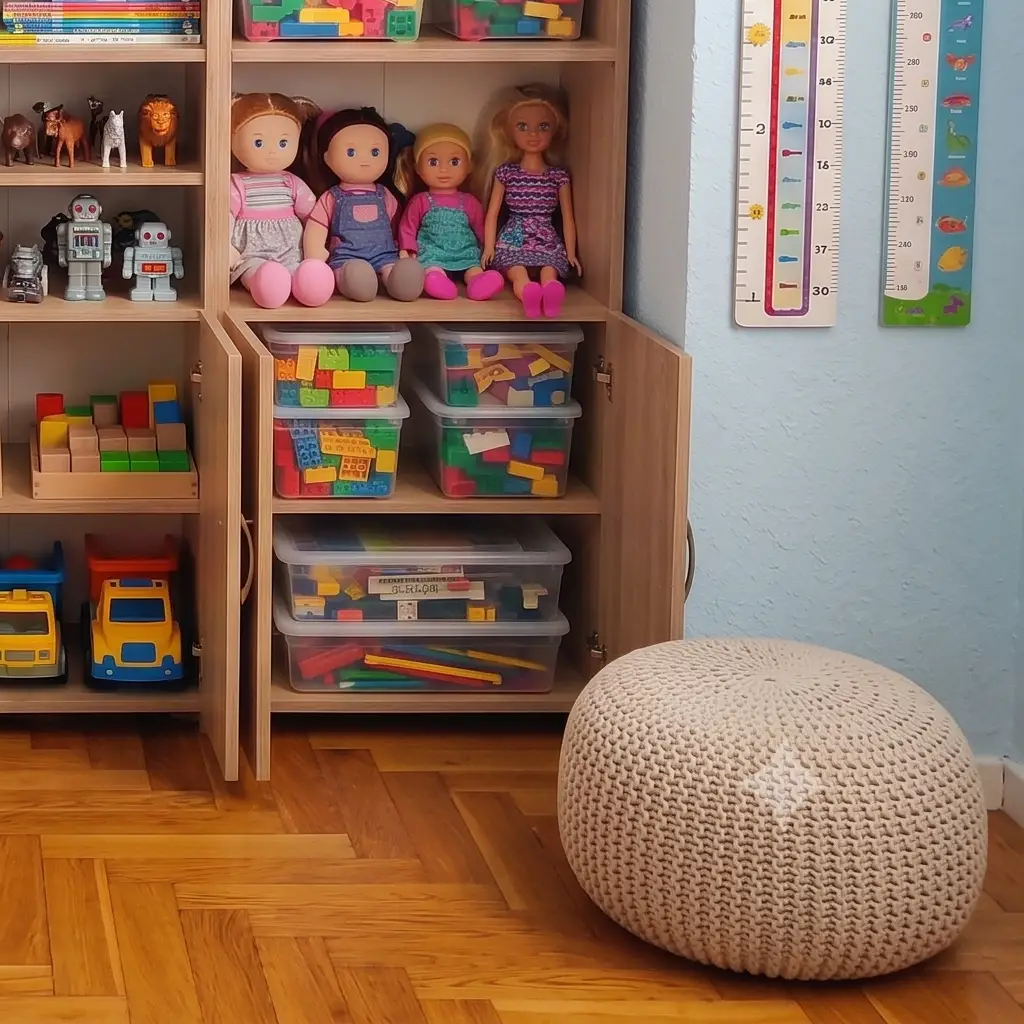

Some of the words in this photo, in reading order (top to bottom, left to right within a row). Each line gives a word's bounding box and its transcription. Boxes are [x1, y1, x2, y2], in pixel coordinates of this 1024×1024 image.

[819, 120, 831, 128] 10
[815, 246, 827, 254] 37
[813, 287, 829, 295] 30
